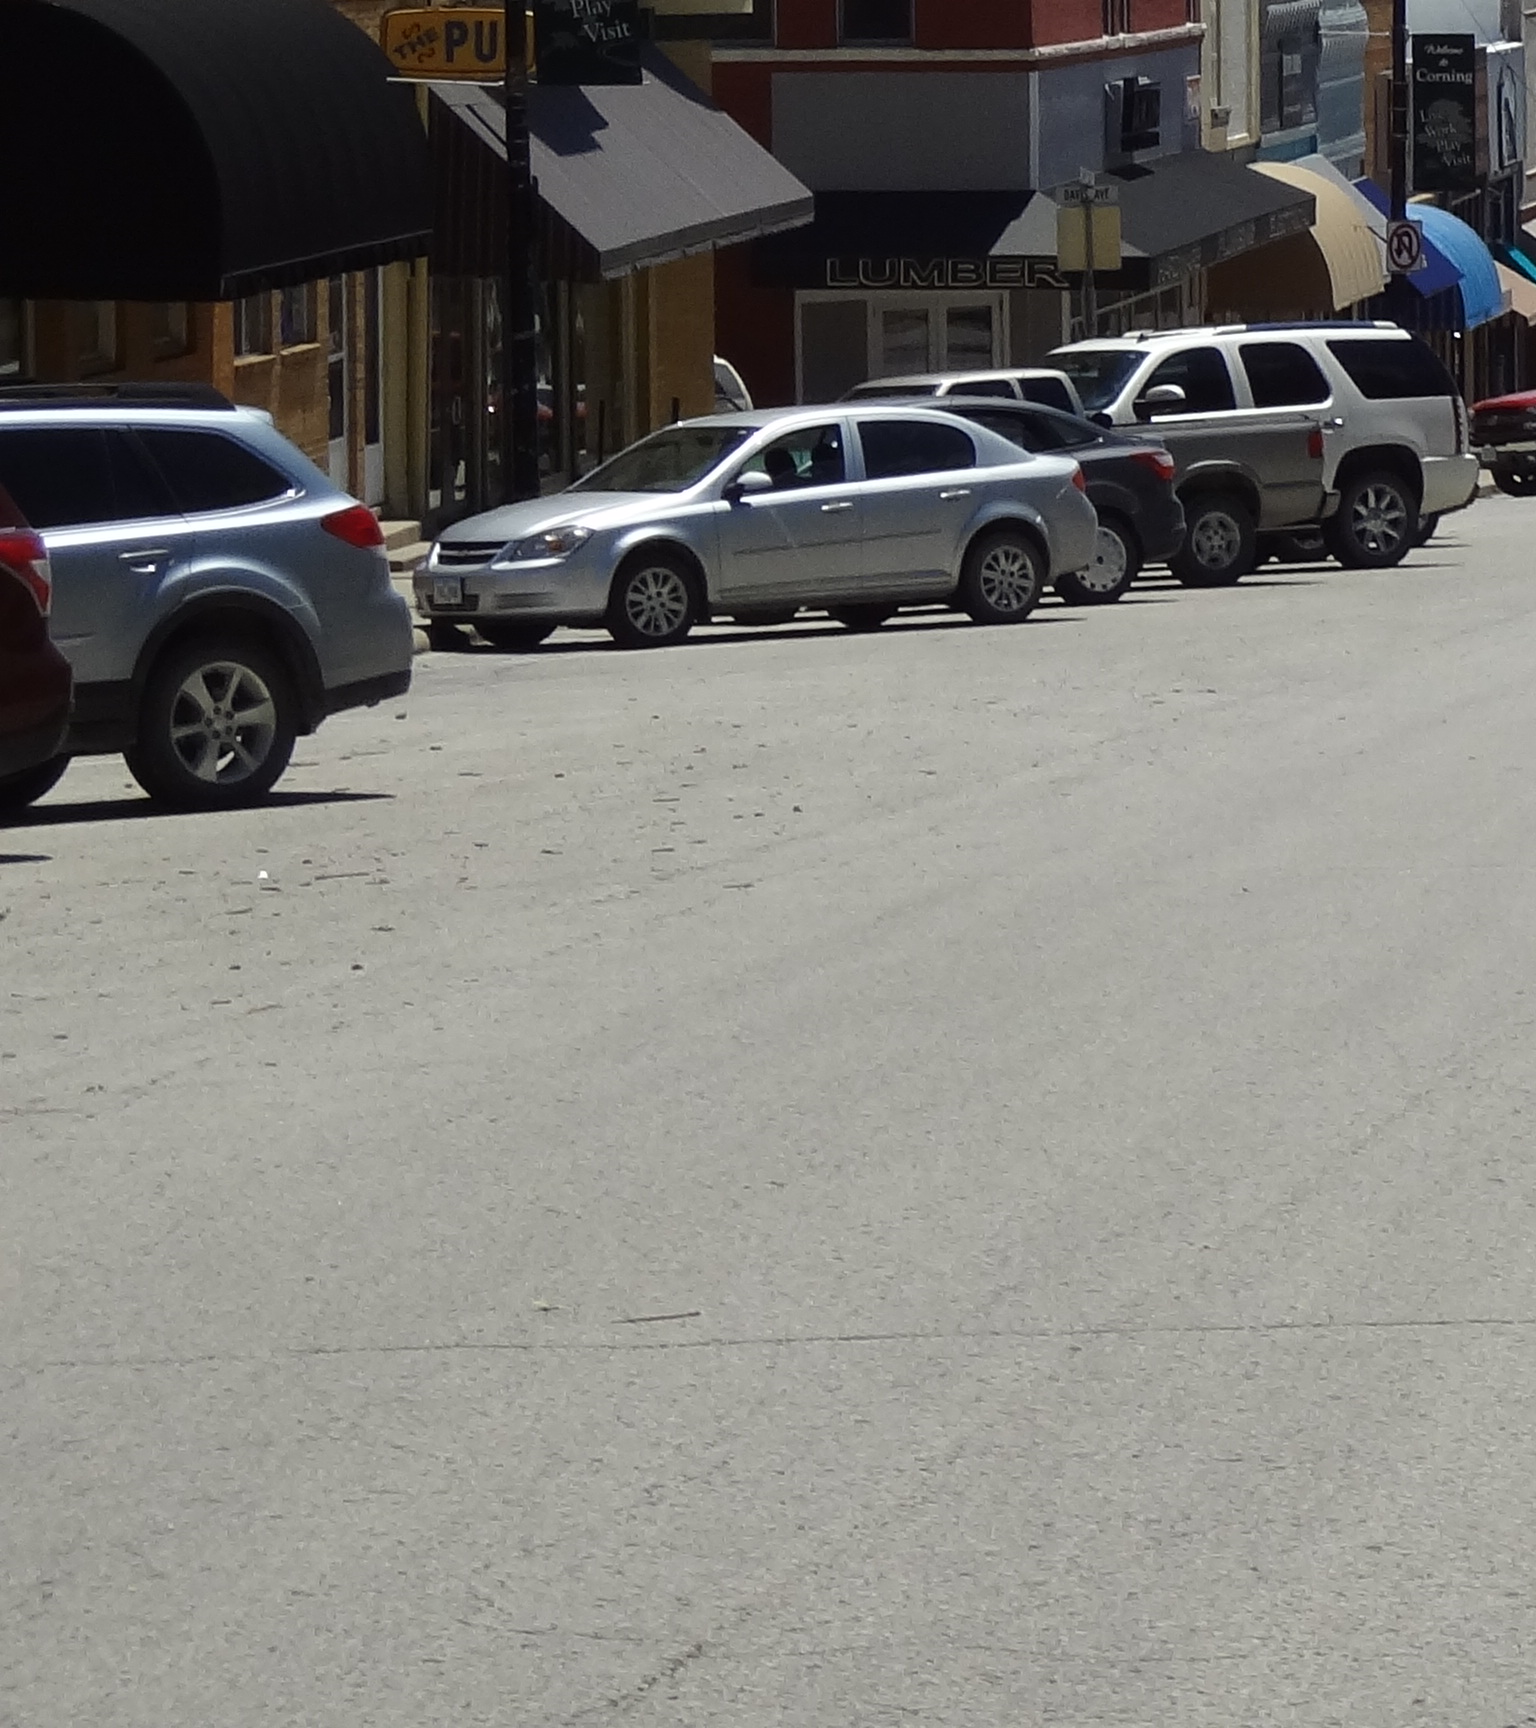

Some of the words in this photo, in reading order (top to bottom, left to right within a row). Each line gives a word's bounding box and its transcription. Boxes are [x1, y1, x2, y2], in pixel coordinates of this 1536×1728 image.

[444, 20, 499, 63] PU
[583, 19, 631, 43] Visit
[1415, 68, 1474, 85] Corning
[1442, 154, 1472, 167] Visit
[826, 257, 1070, 288] LUMBER
